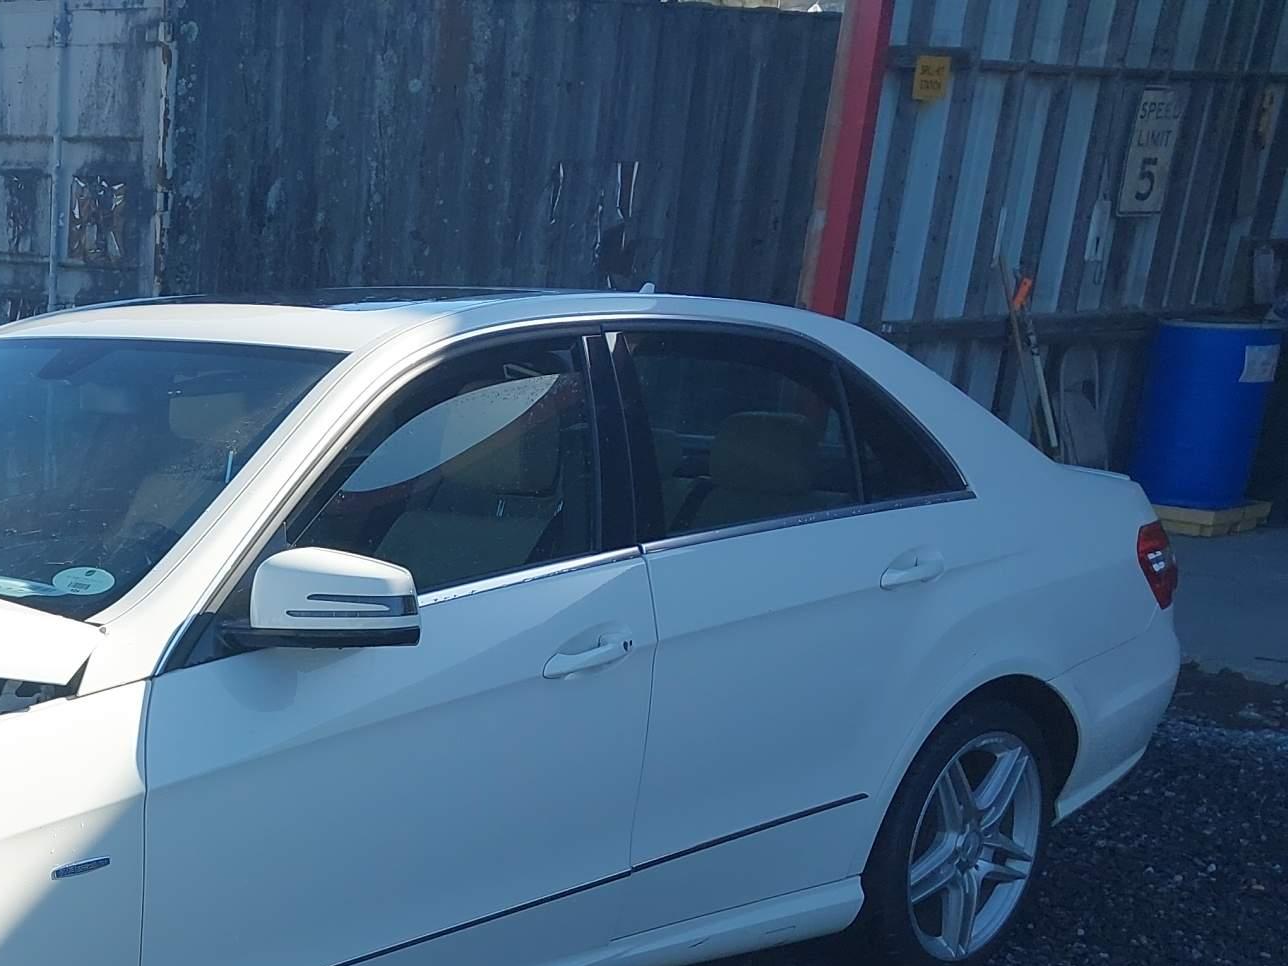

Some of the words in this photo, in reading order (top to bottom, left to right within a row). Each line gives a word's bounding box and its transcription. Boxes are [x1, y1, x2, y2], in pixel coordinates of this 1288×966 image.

[1138, 101, 1182, 120] SPEED
[1137, 129, 1173, 147] LIMIT
[1134, 156, 1159, 201] 5
